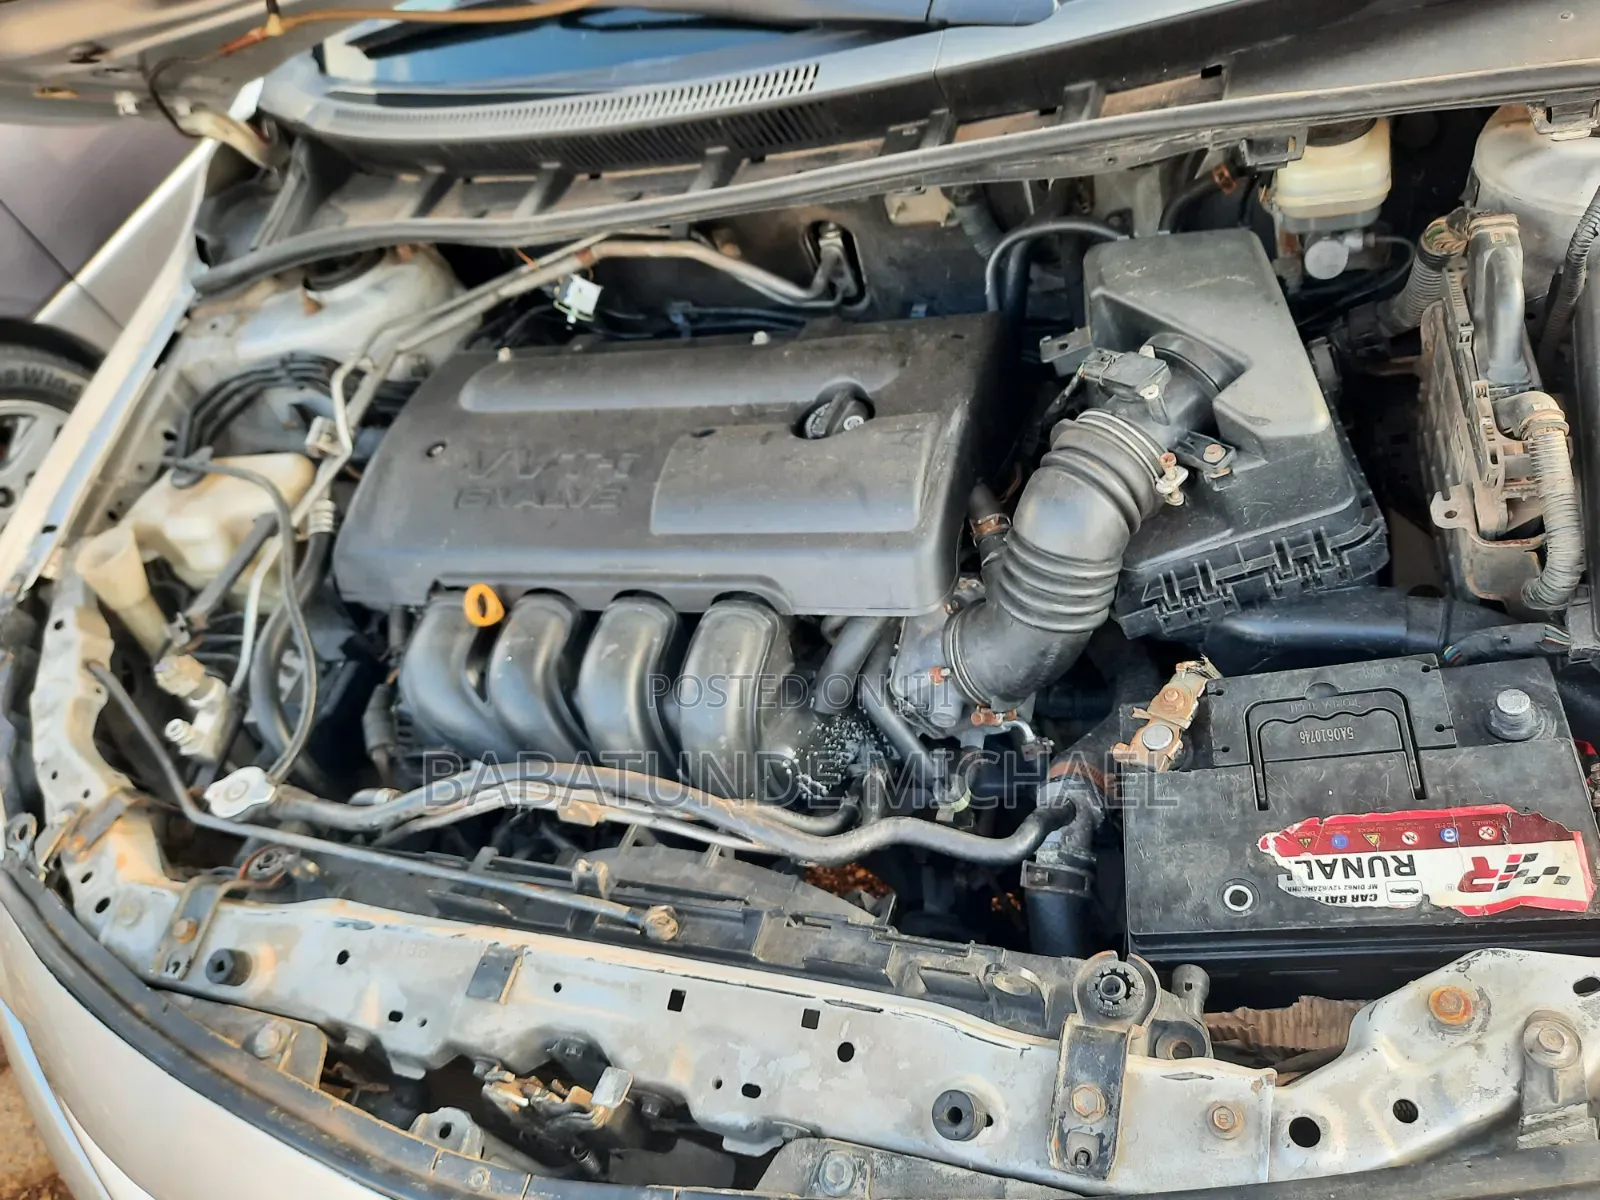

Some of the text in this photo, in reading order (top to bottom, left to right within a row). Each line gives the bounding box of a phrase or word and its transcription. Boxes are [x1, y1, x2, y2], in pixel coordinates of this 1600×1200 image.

[1299, 726, 1355, 744] 5A0610746
[1286, 854, 1417, 881] RUNAL
[1351, 893, 1378, 903] CAR
